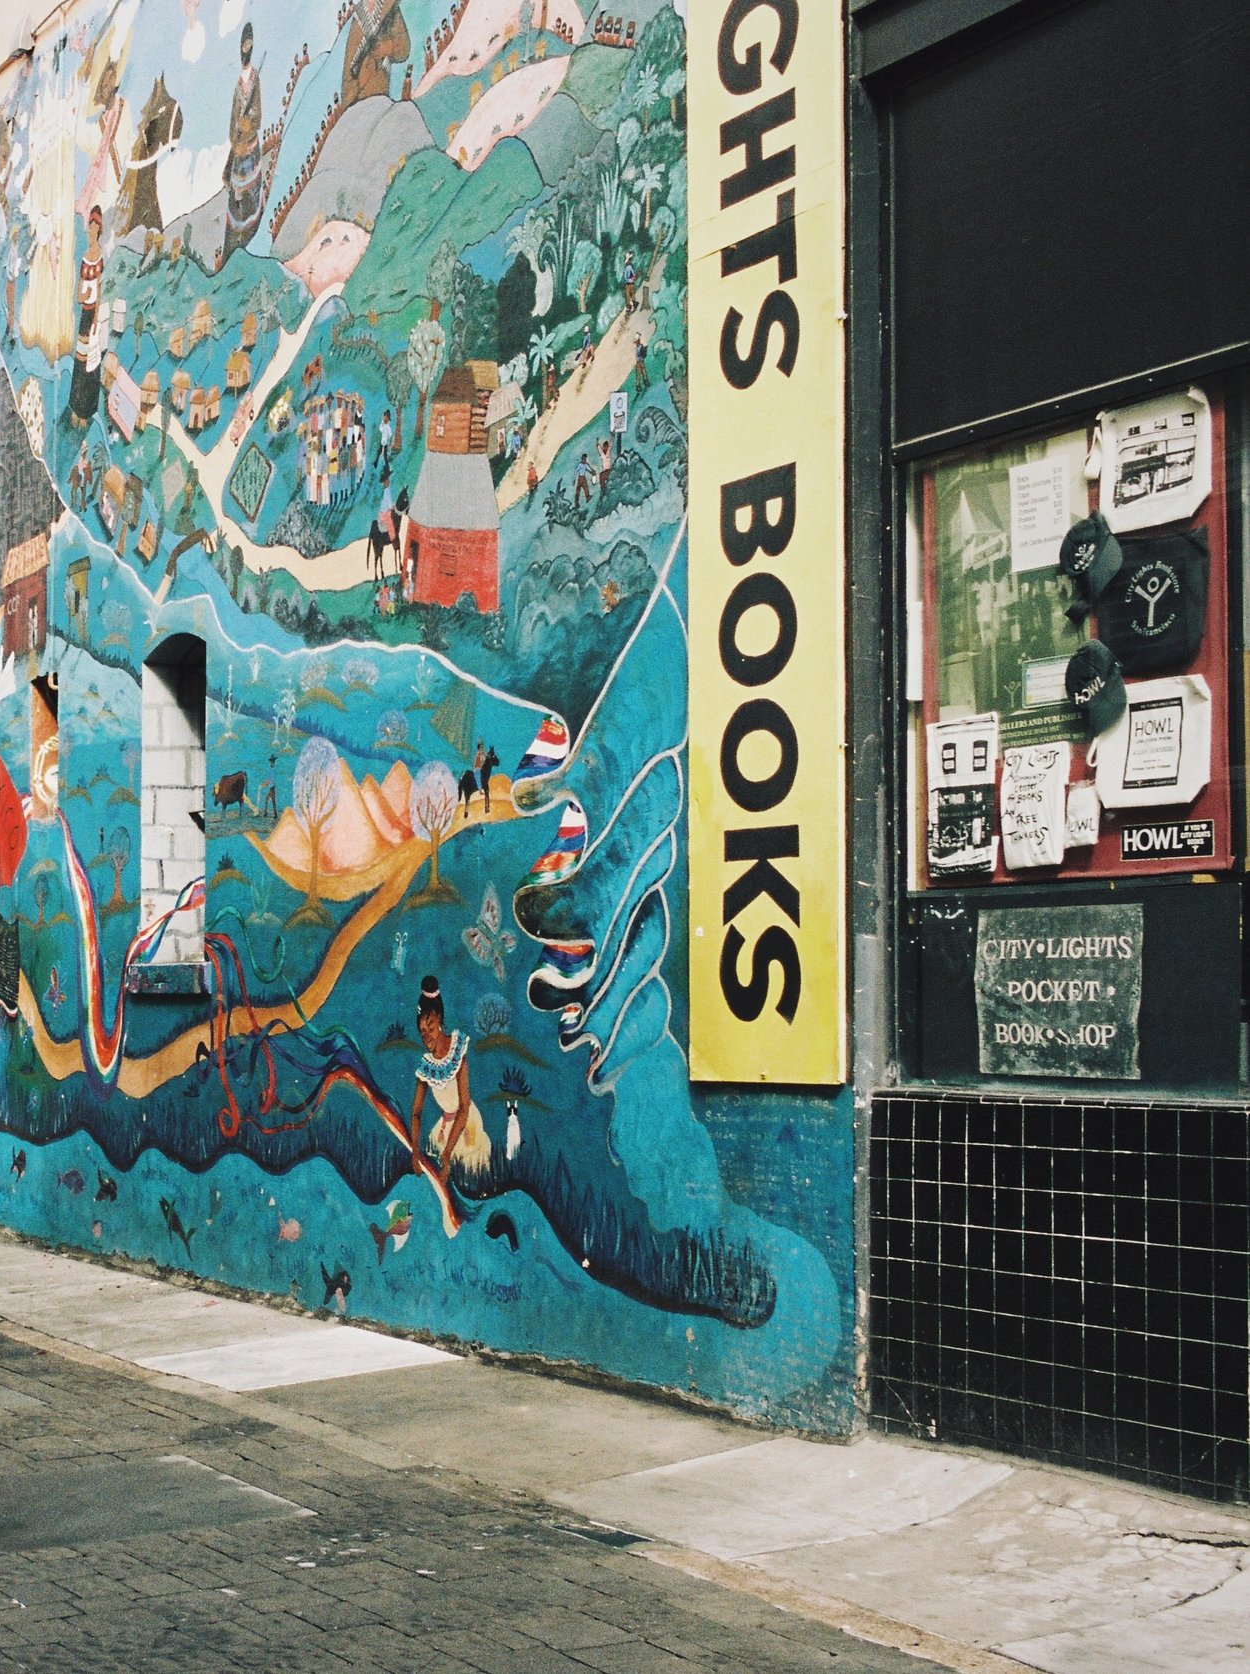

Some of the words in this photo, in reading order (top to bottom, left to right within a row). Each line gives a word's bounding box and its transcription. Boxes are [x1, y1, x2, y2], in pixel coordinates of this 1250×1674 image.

[1074, 676, 1106, 705] HOWL
[999, 720, 1028, 731] SELLERS
[1134, 717, 1174, 737] HOWL
[718, 461, 802, 1027] BOOKS
[1123, 826, 1184, 852] HOWL
[1007, 978, 1101, 1003] POCKET
